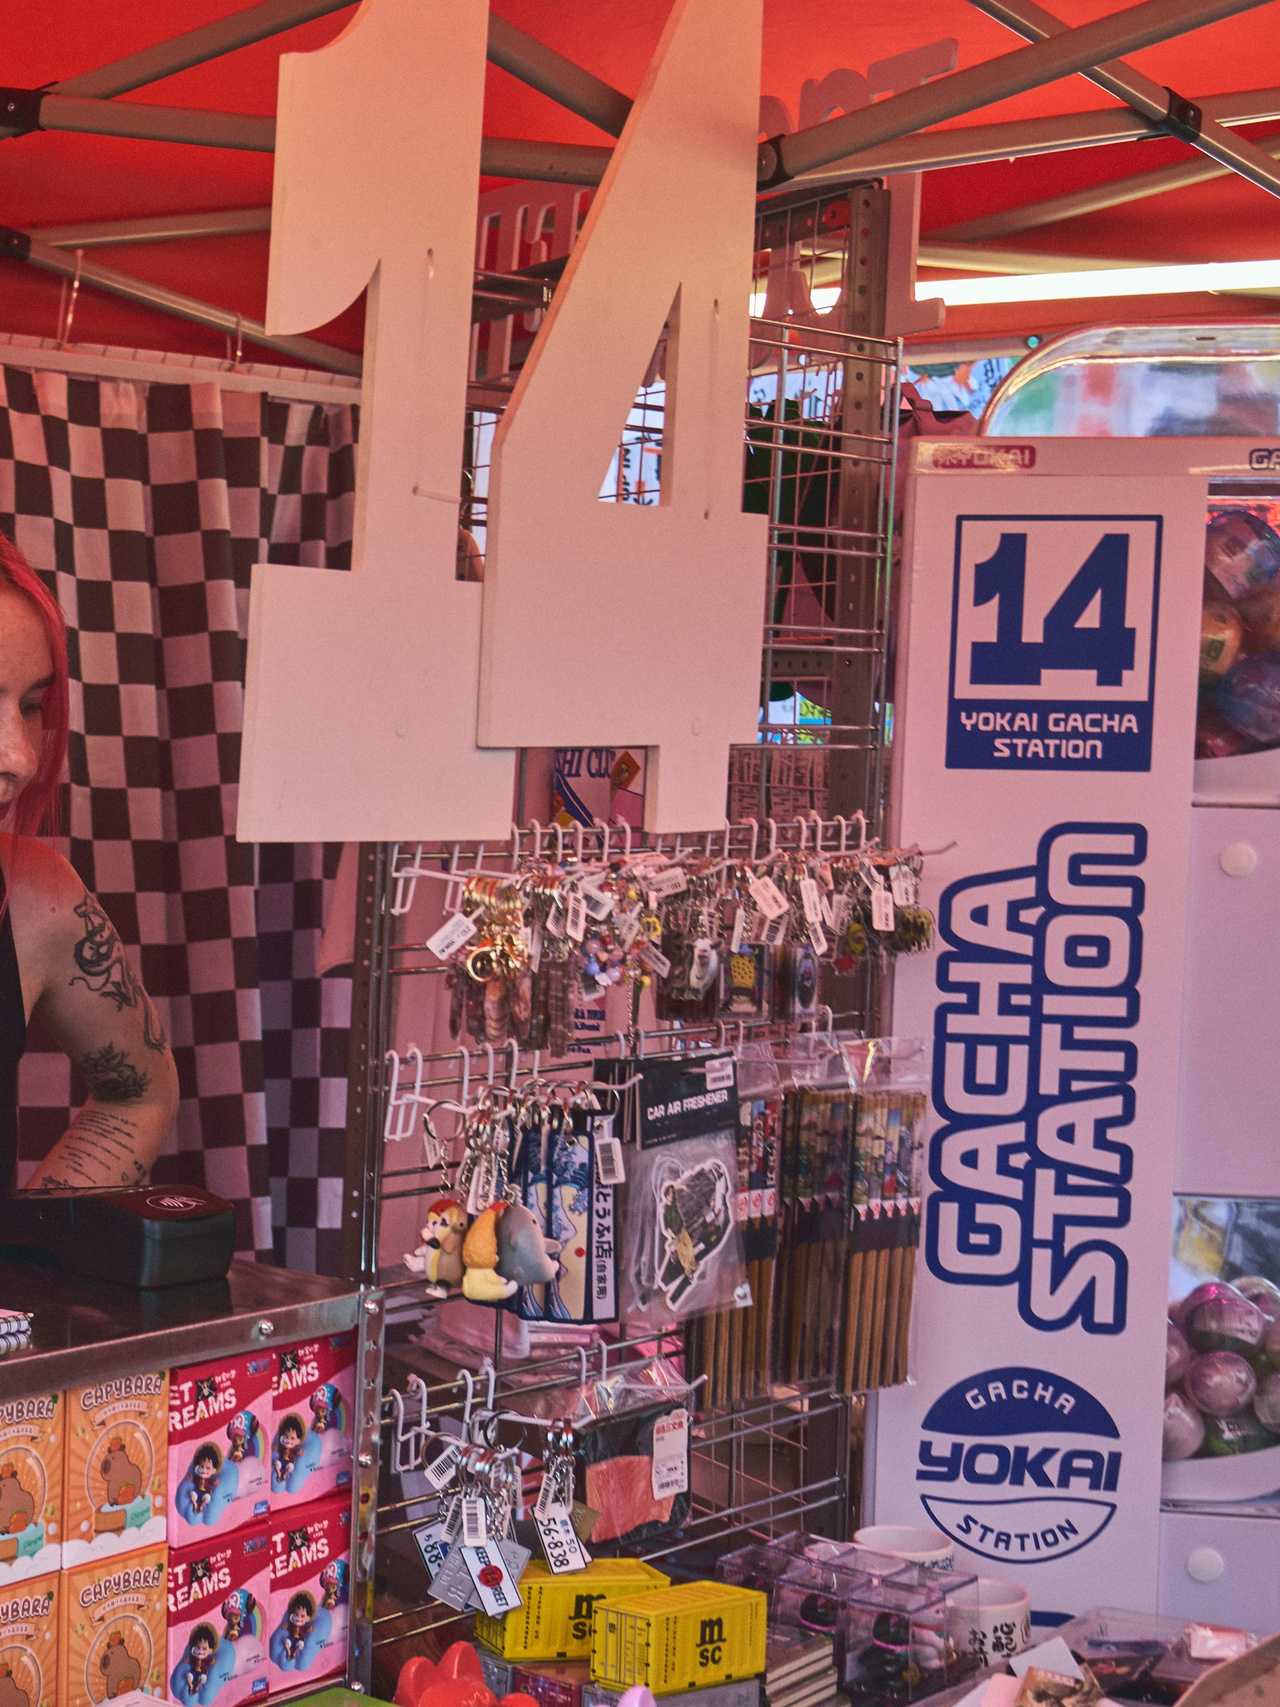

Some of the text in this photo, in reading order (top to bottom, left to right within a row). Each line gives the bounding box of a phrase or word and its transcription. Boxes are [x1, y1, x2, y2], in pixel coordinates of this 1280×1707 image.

[970, 533, 1137, 687] 14
[960, 711, 1139, 734] YOKAI GACHA
[993, 738, 1103, 759] STATION
[925, 864, 1041, 1287] GACHA
[1018, 821, 1148, 1335] STATION
[647, 1089, 729, 1121] CAR AIR FRESHENER
[81, 1373, 164, 1411] CAPYBARA
[965, 1379, 1076, 1416] GACHA
[916, 1440, 1122, 1492] YOKAI
[541, 1517, 570, 1568] 56-838
[956, 1513, 1079, 1552] STATION
[80, 1567, 162, 1608] CAPYBARA
